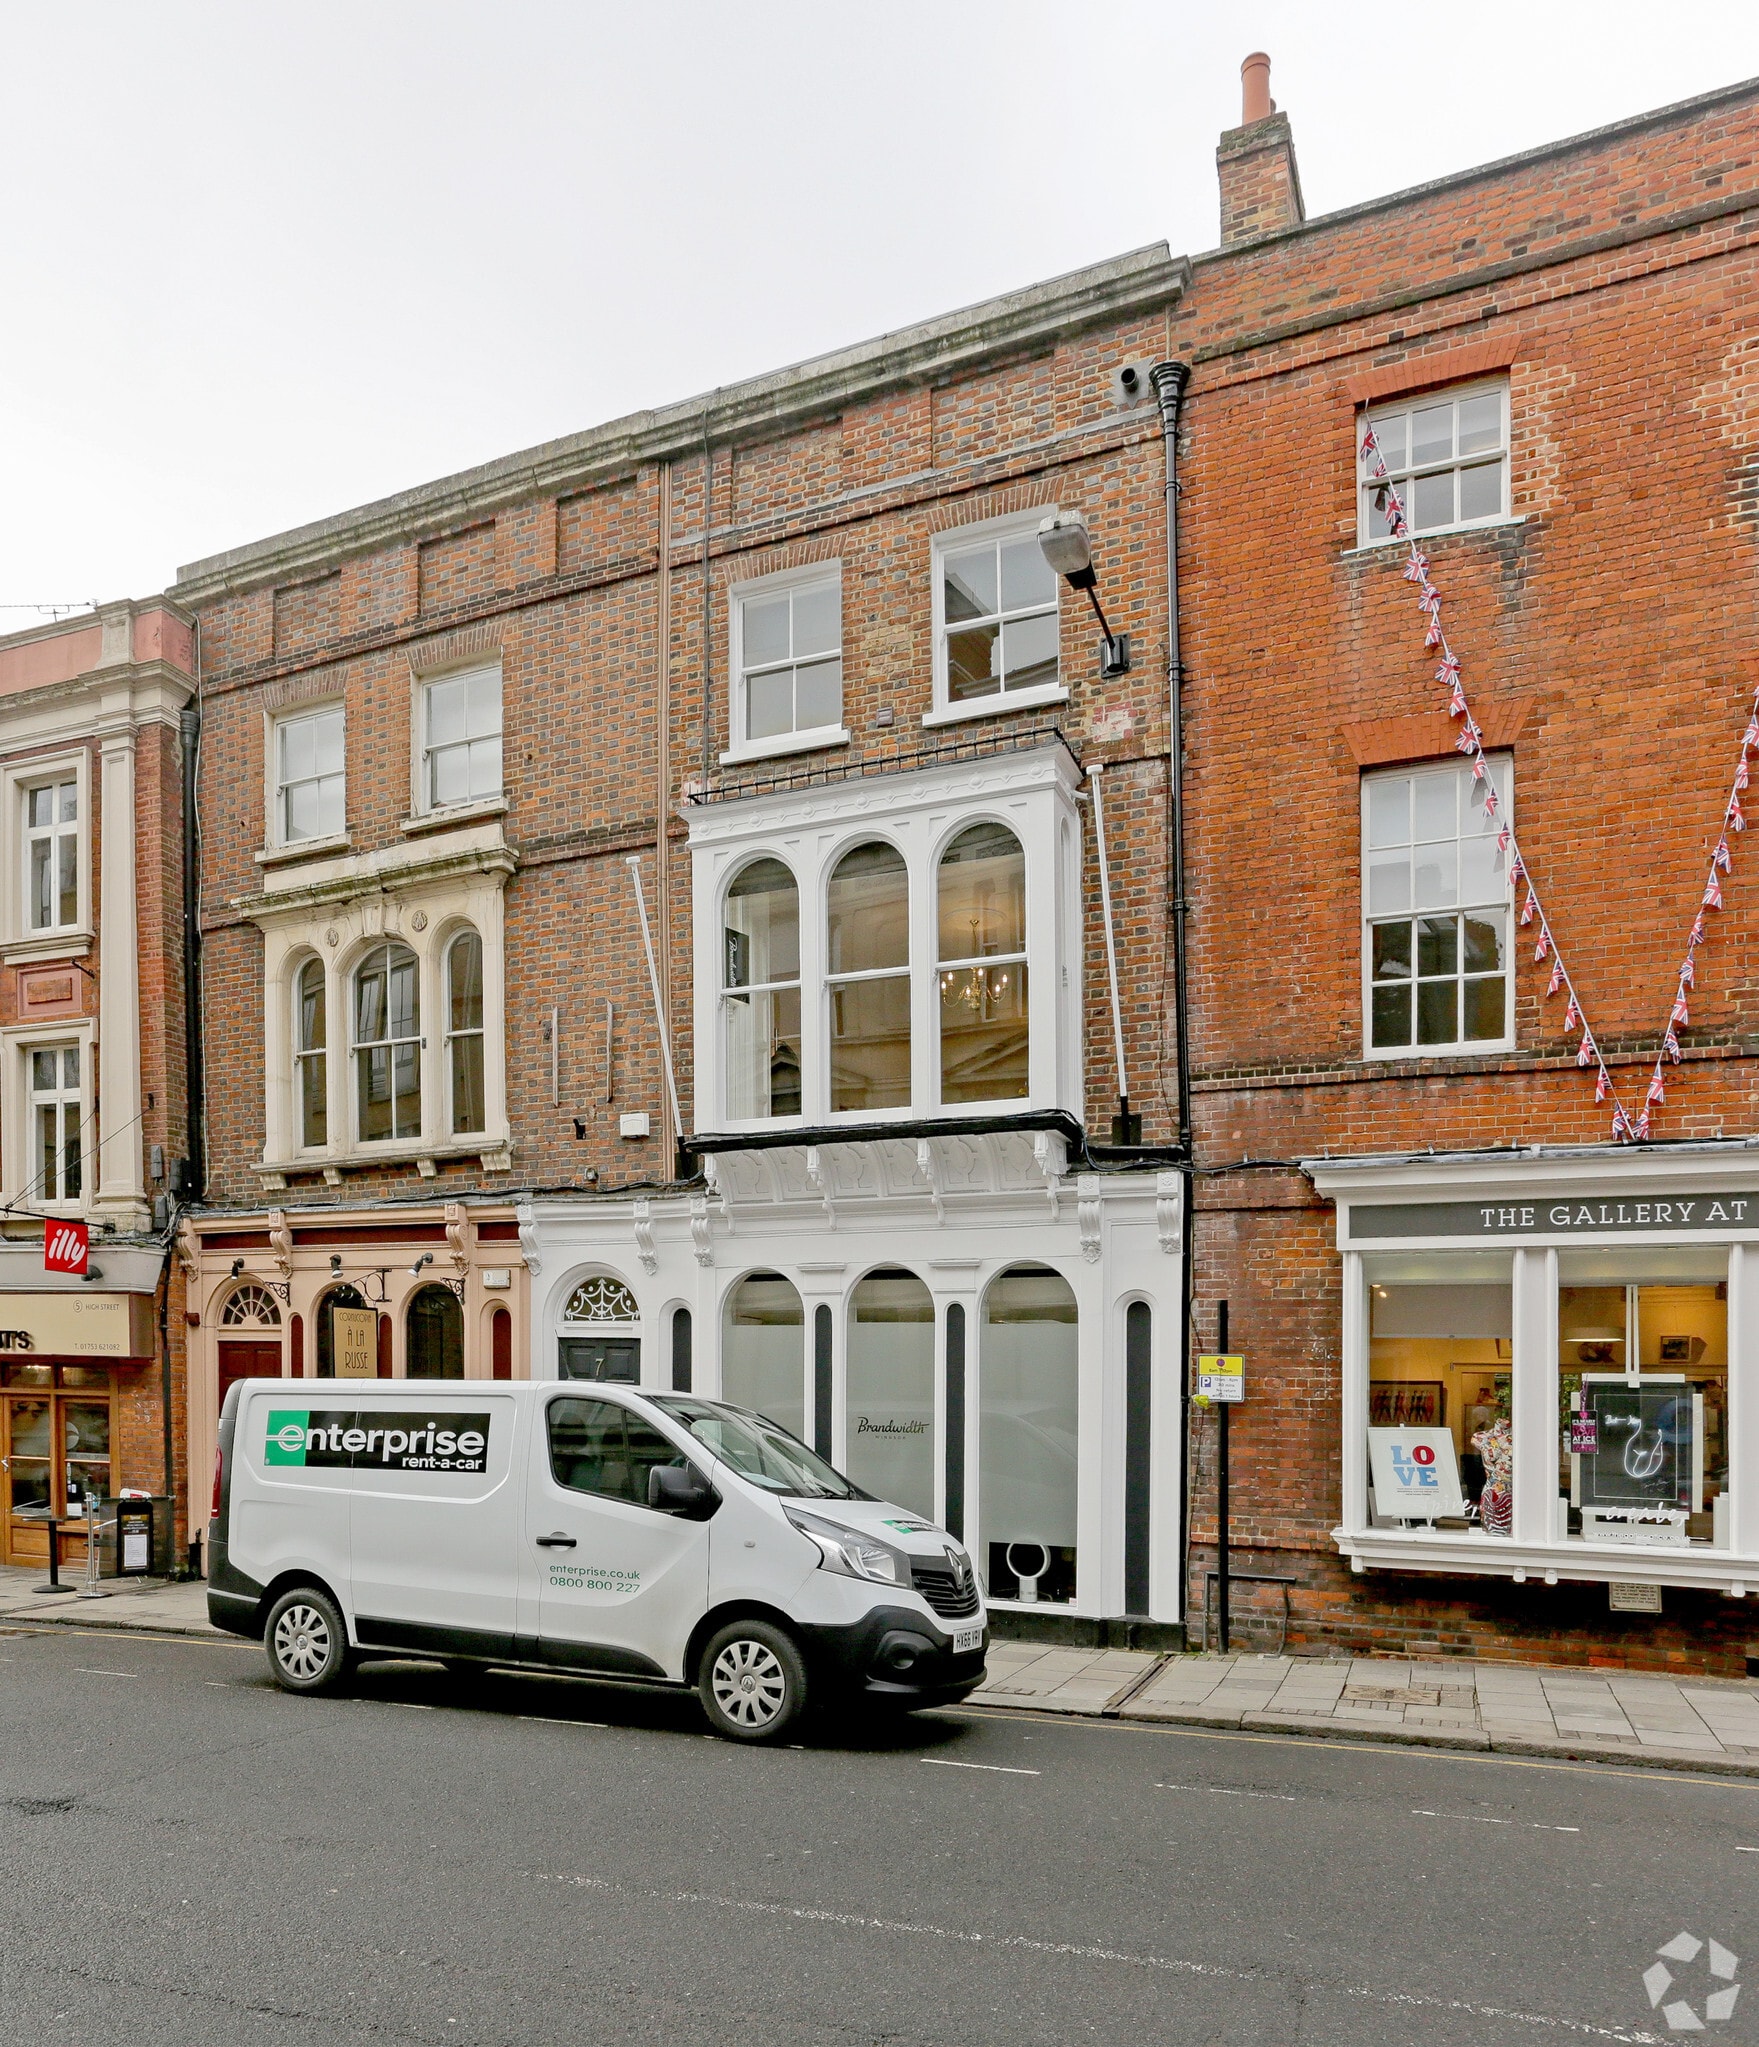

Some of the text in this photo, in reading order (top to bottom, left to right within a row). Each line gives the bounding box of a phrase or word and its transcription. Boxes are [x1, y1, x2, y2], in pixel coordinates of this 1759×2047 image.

[1481, 1200, 1747, 1227] THE GALLERY AT
[48, 1228, 86, 1269] illy
[100, 1303, 120, 1311] STREET
[356, 1329, 365, 1347] LA
[344, 1351, 368, 1369] RUSSE
[595, 1358, 605, 1376] 7
[857, 1416, 930, 1434] Brandwidth
[266, 1421, 485, 1462] enterprise
[401, 1456, 483, 1470] rent-a-car
[549, 1564, 641, 1580] enterprise.co.uk
[549, 1576, 640, 1593] 0800 800 227
